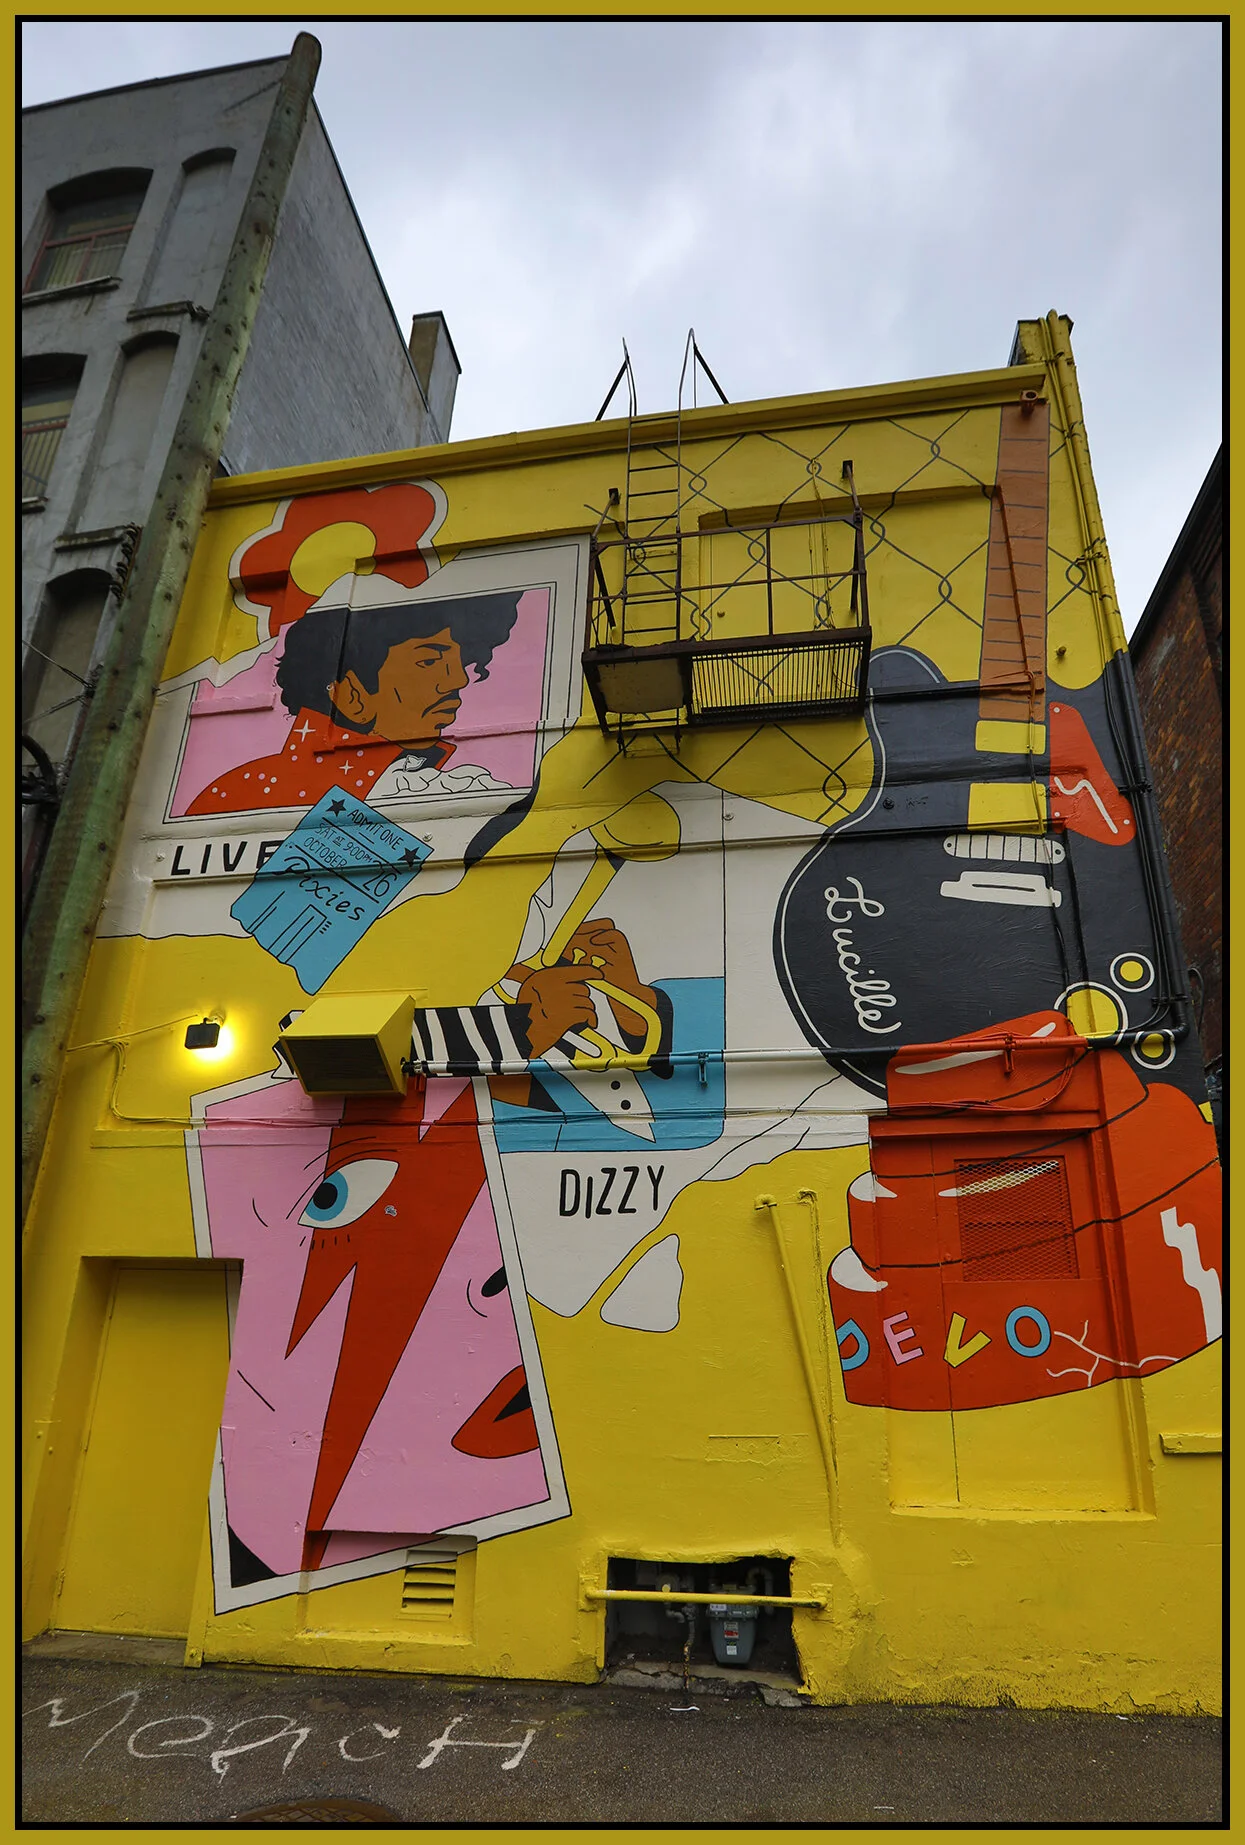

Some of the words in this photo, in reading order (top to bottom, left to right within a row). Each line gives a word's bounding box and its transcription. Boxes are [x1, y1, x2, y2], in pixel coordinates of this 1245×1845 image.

[171, 839, 286, 876] LIVE
[314, 822, 337, 841] SAT
[332, 836, 346, 846] AT
[347, 808, 383, 835] ADMIT
[379, 829, 404, 851] ONE
[274, 855, 366, 922] Pixies
[303, 836, 348, 870] OCTOBER
[362, 860, 398, 898] 26
[824, 876, 902, 1034] Lucille
[559, 1164, 665, 1219] DIZZY
[836, 1304, 1052, 1372] DEVO
